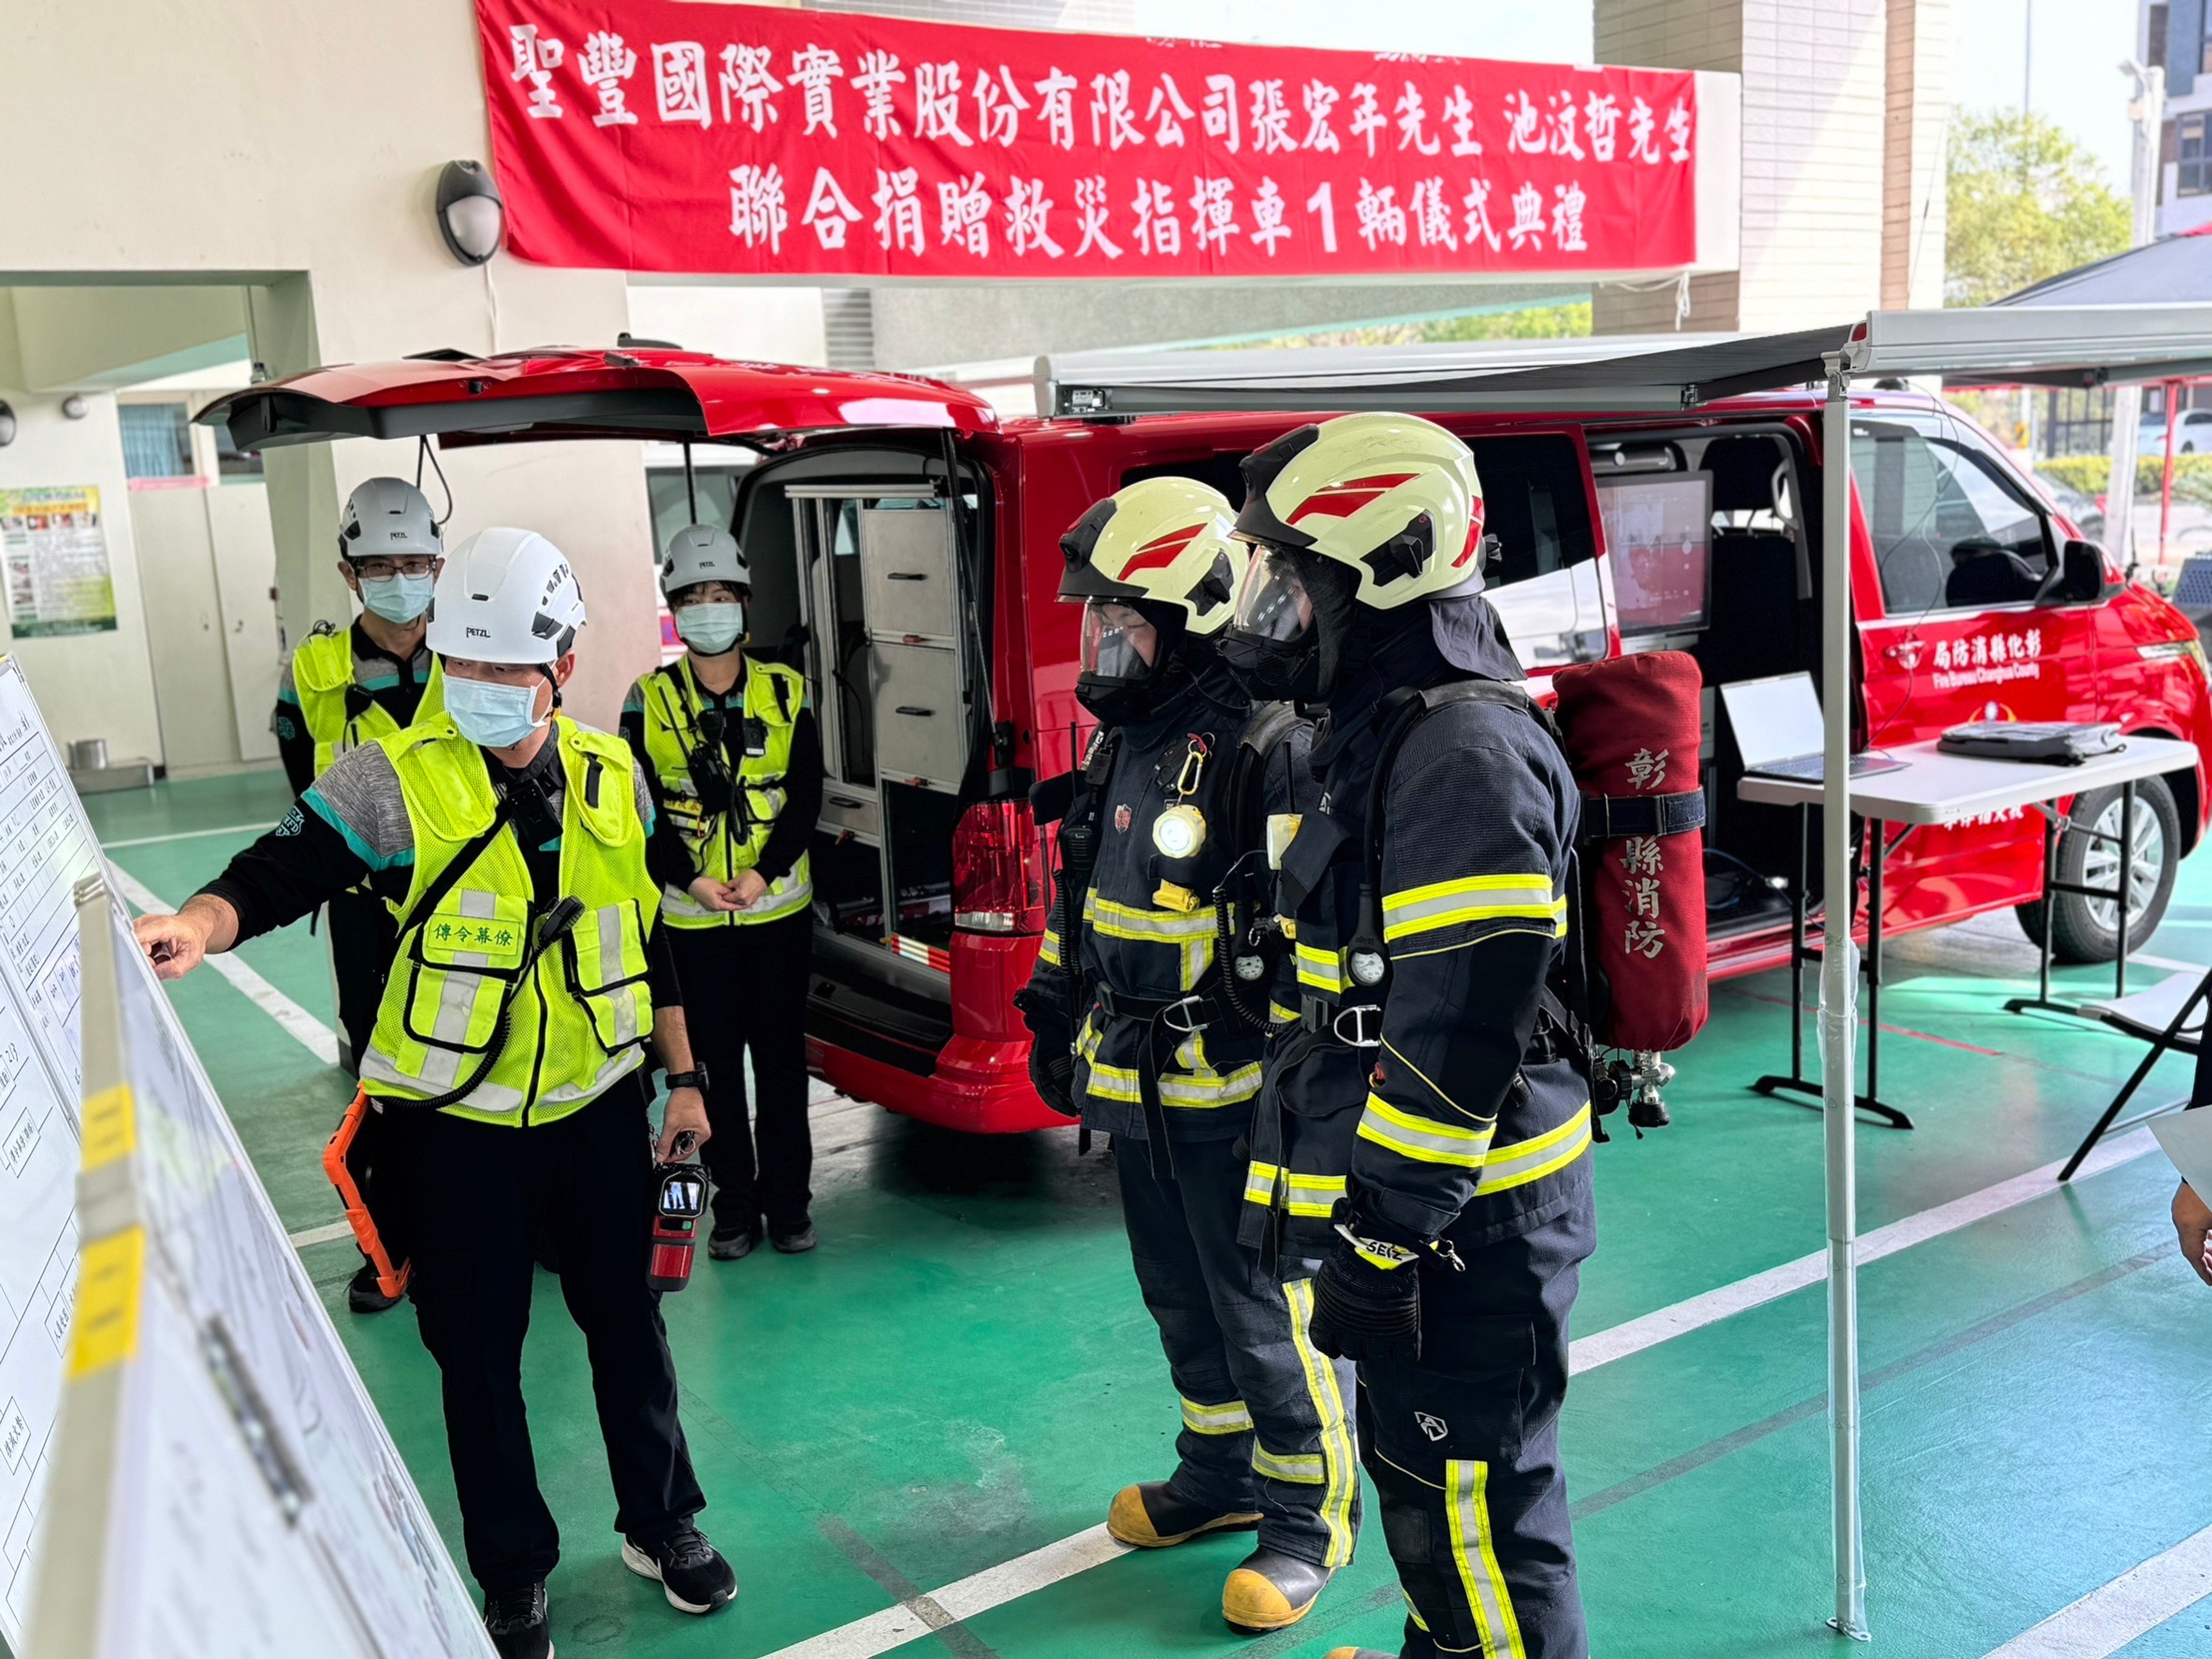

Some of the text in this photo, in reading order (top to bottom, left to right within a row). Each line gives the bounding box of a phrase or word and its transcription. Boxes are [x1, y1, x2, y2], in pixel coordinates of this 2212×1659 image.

[728, 162, 1589, 258] 聯合捐贈救災指揮車1輛儀式典禮
[466, 626, 491, 638] PETZL
[1932, 672, 1950, 689] Fire
[1619, 748, 1669, 959] 彰縣消防
[432, 923, 514, 947] 傳令幕僚
[1365, 1241, 1404, 1261] SEIZ
